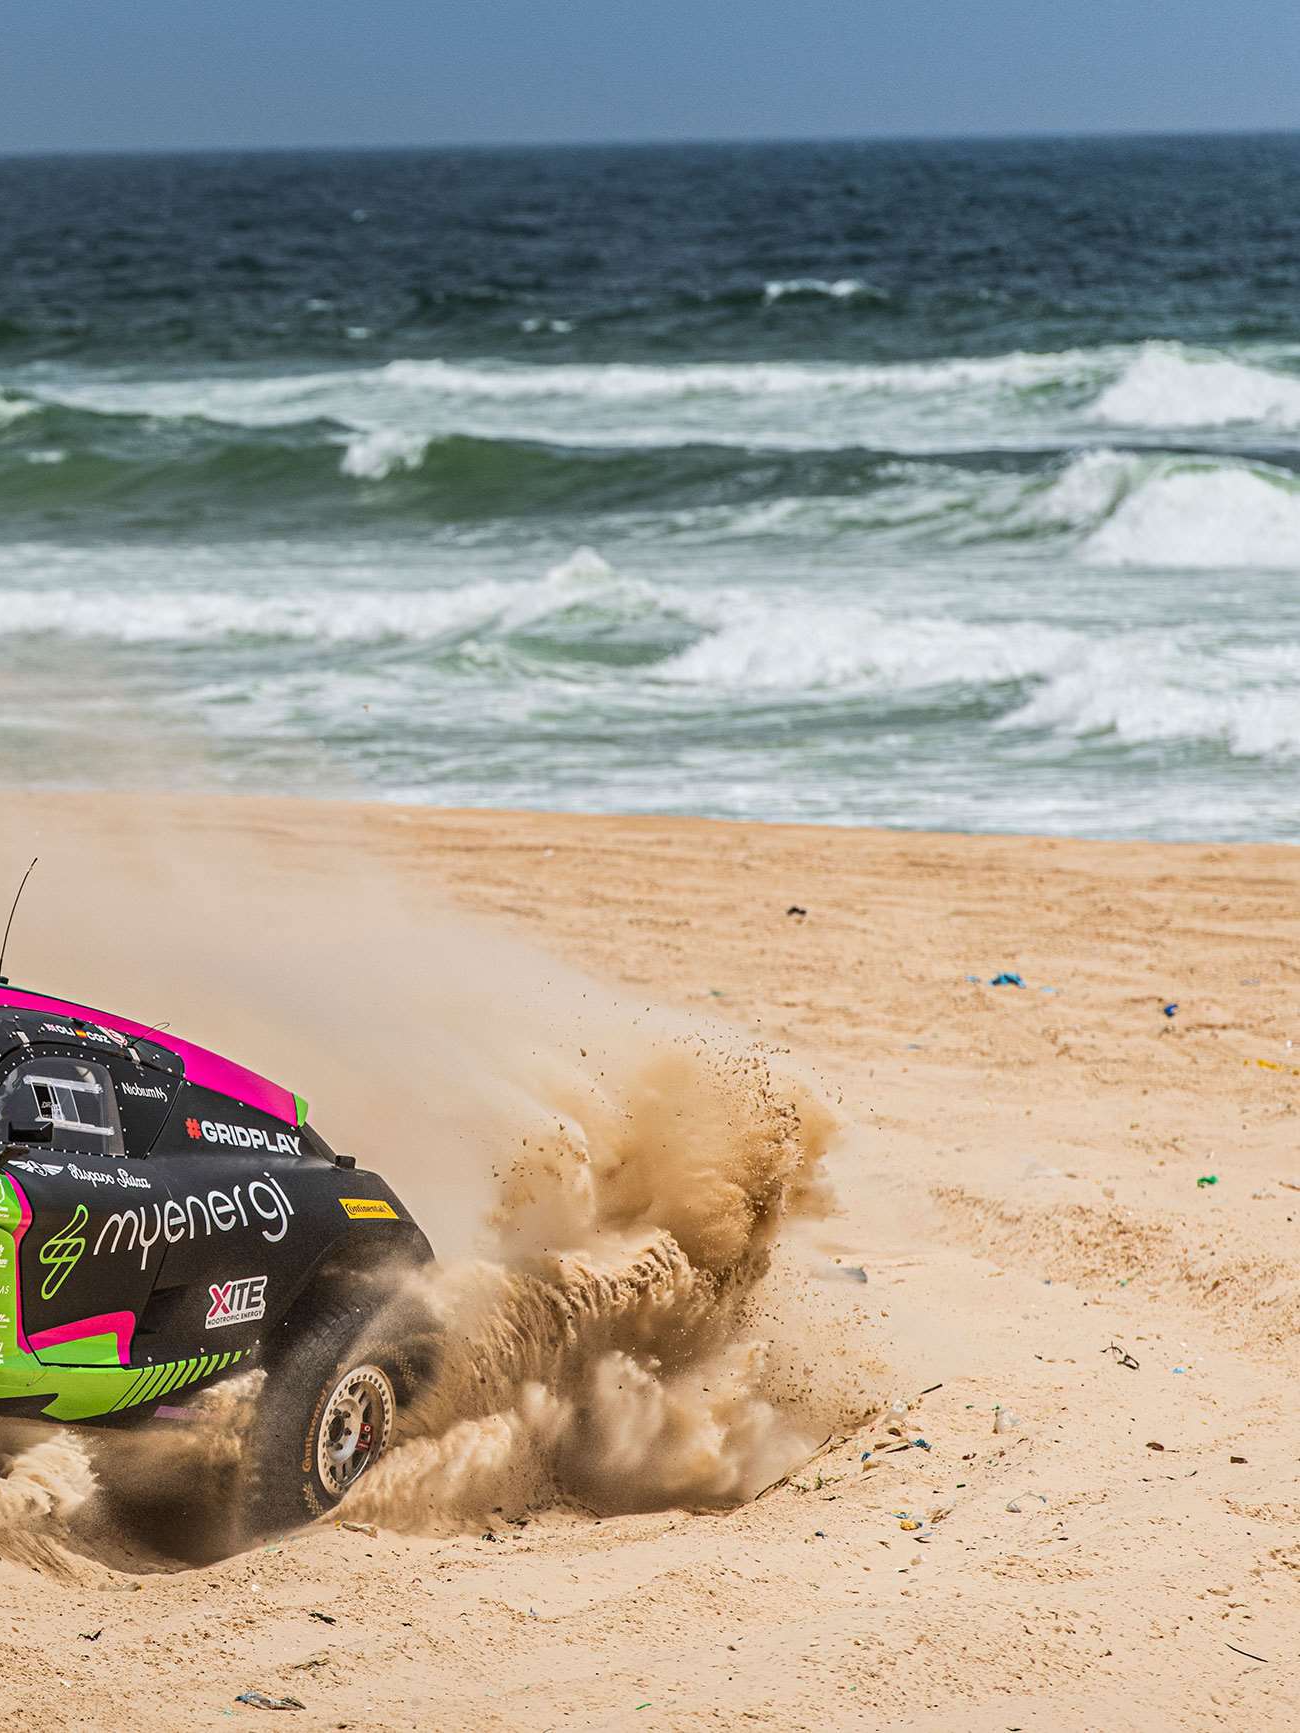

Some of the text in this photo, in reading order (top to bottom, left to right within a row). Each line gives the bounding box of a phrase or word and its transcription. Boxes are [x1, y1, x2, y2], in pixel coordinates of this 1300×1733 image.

[184, 1117, 302, 1156] #GRIDPLAY
[67, 1163, 151, 1189] Hispano Suiza
[93, 1171, 295, 1270] myenergi
[346, 1203, 386, 1215] Continental
[208, 1279, 265, 1317] XITE
[241, 1309, 263, 1320] ENERGY
